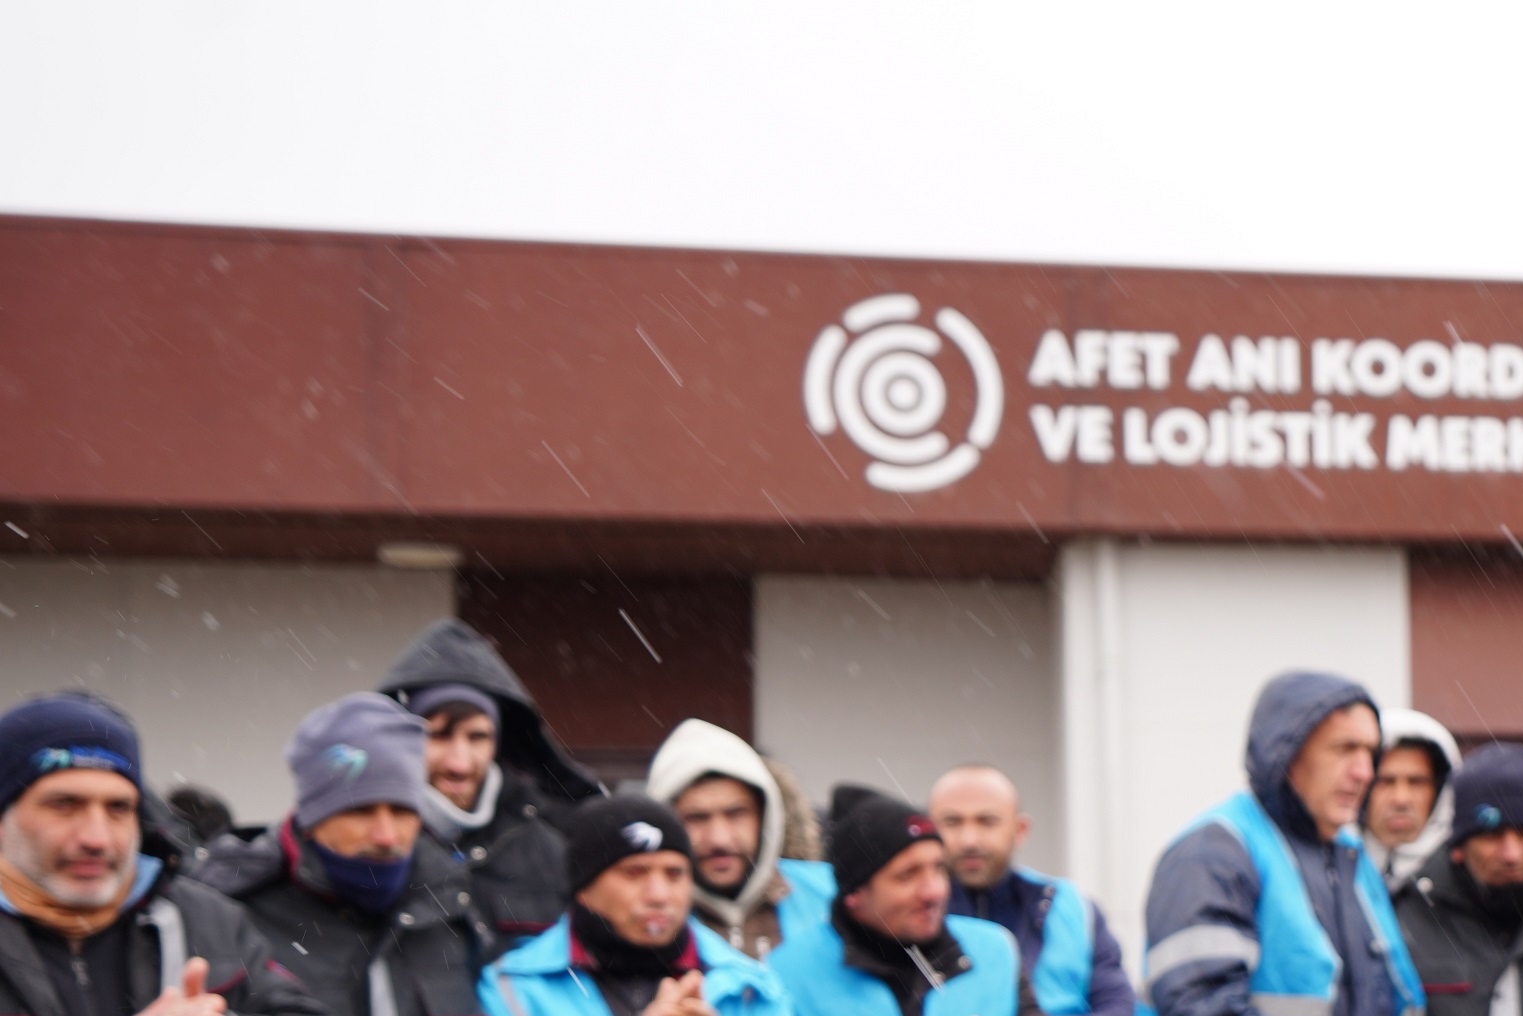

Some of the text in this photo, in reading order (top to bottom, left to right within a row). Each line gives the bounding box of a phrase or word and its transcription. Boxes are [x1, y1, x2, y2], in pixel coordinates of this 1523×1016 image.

[1030, 331, 1179, 389] AFET
[1187, 336, 1300, 393] ANI
[1030, 406, 1113, 462] VE
[1125, 398, 1376, 468] LOJİSTİK
